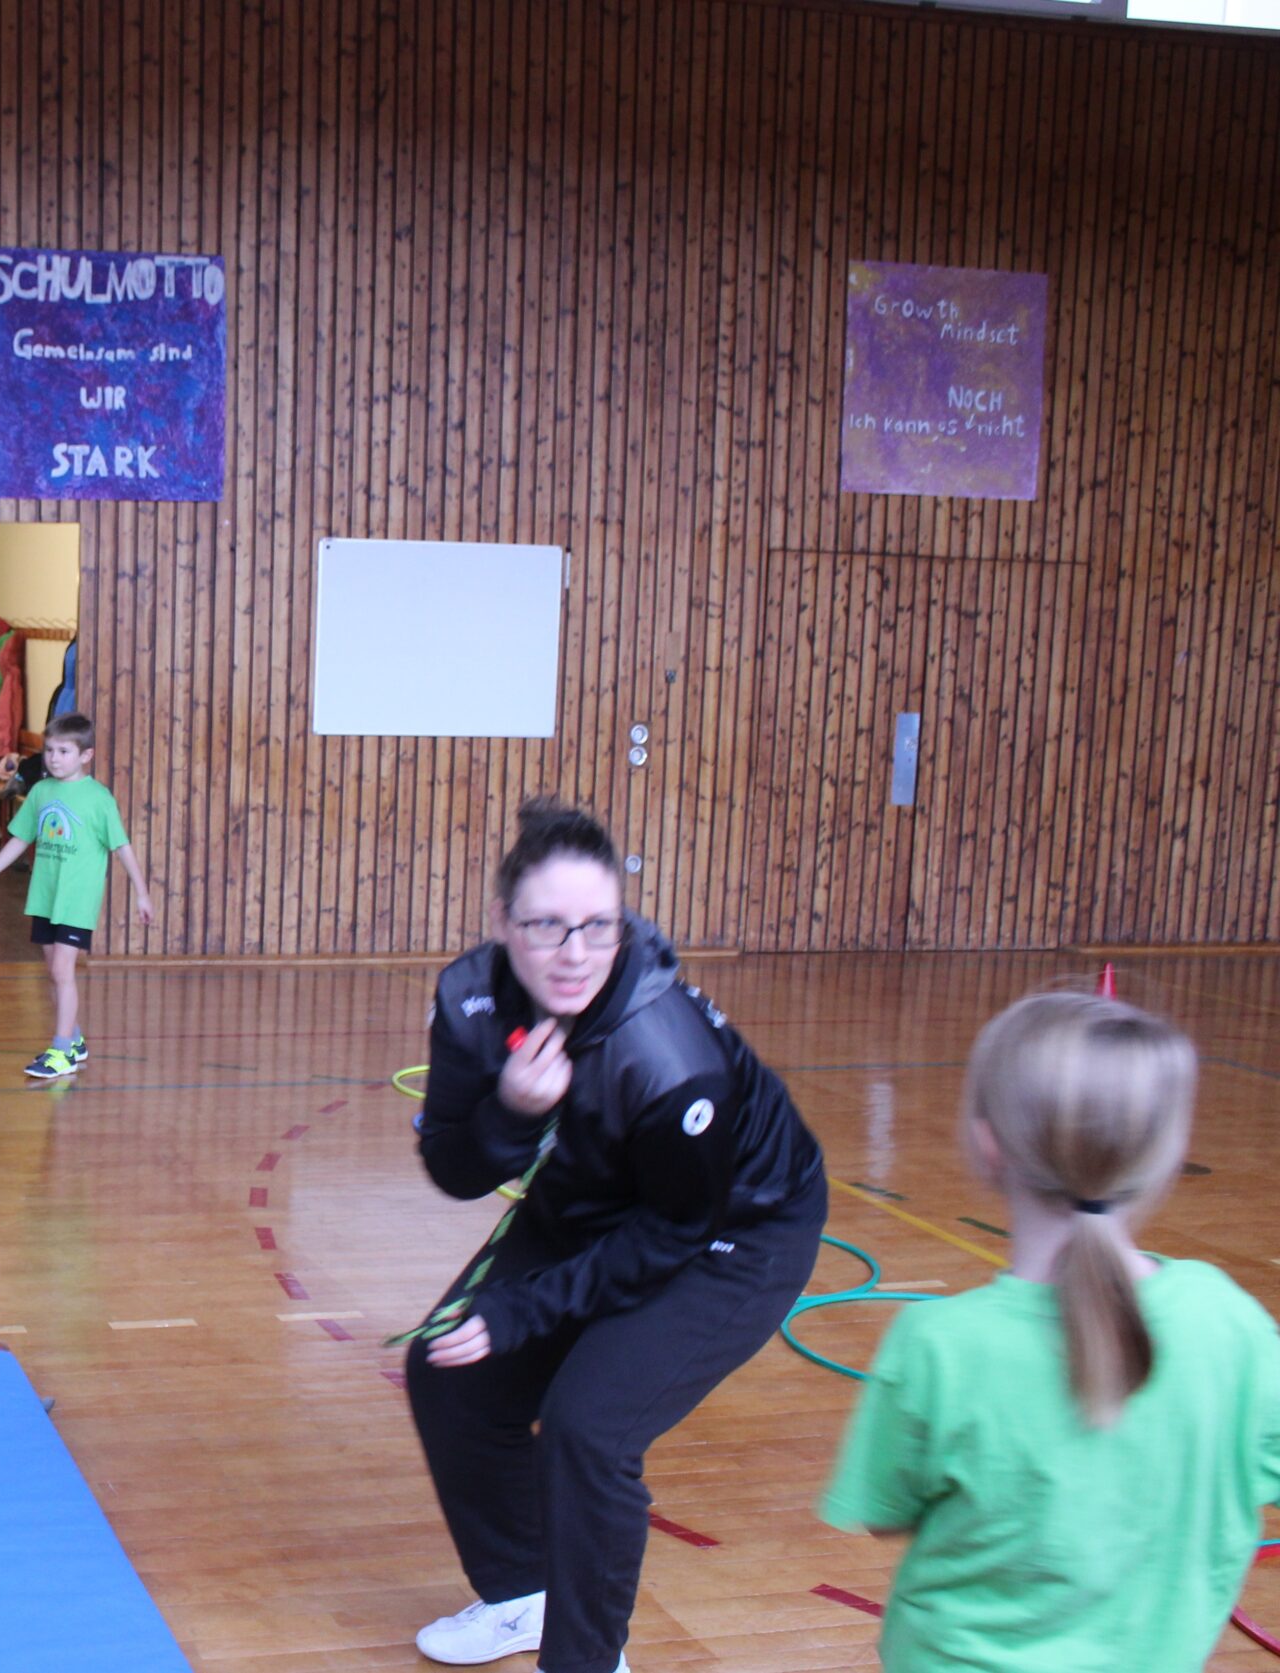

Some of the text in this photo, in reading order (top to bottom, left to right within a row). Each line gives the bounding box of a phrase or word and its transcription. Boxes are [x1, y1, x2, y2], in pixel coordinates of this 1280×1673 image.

[874, 295, 960, 320] Growth
[13, 328, 193, 362] Gemeinsam sind
[940, 320, 1019, 346] Mindset
[80, 385, 126, 410] WIR
[947, 384, 1002, 413] NOCH
[849, 413, 876, 430] Ich
[978, 414, 1026, 438] nicht
[51, 442, 160, 479] STARK
